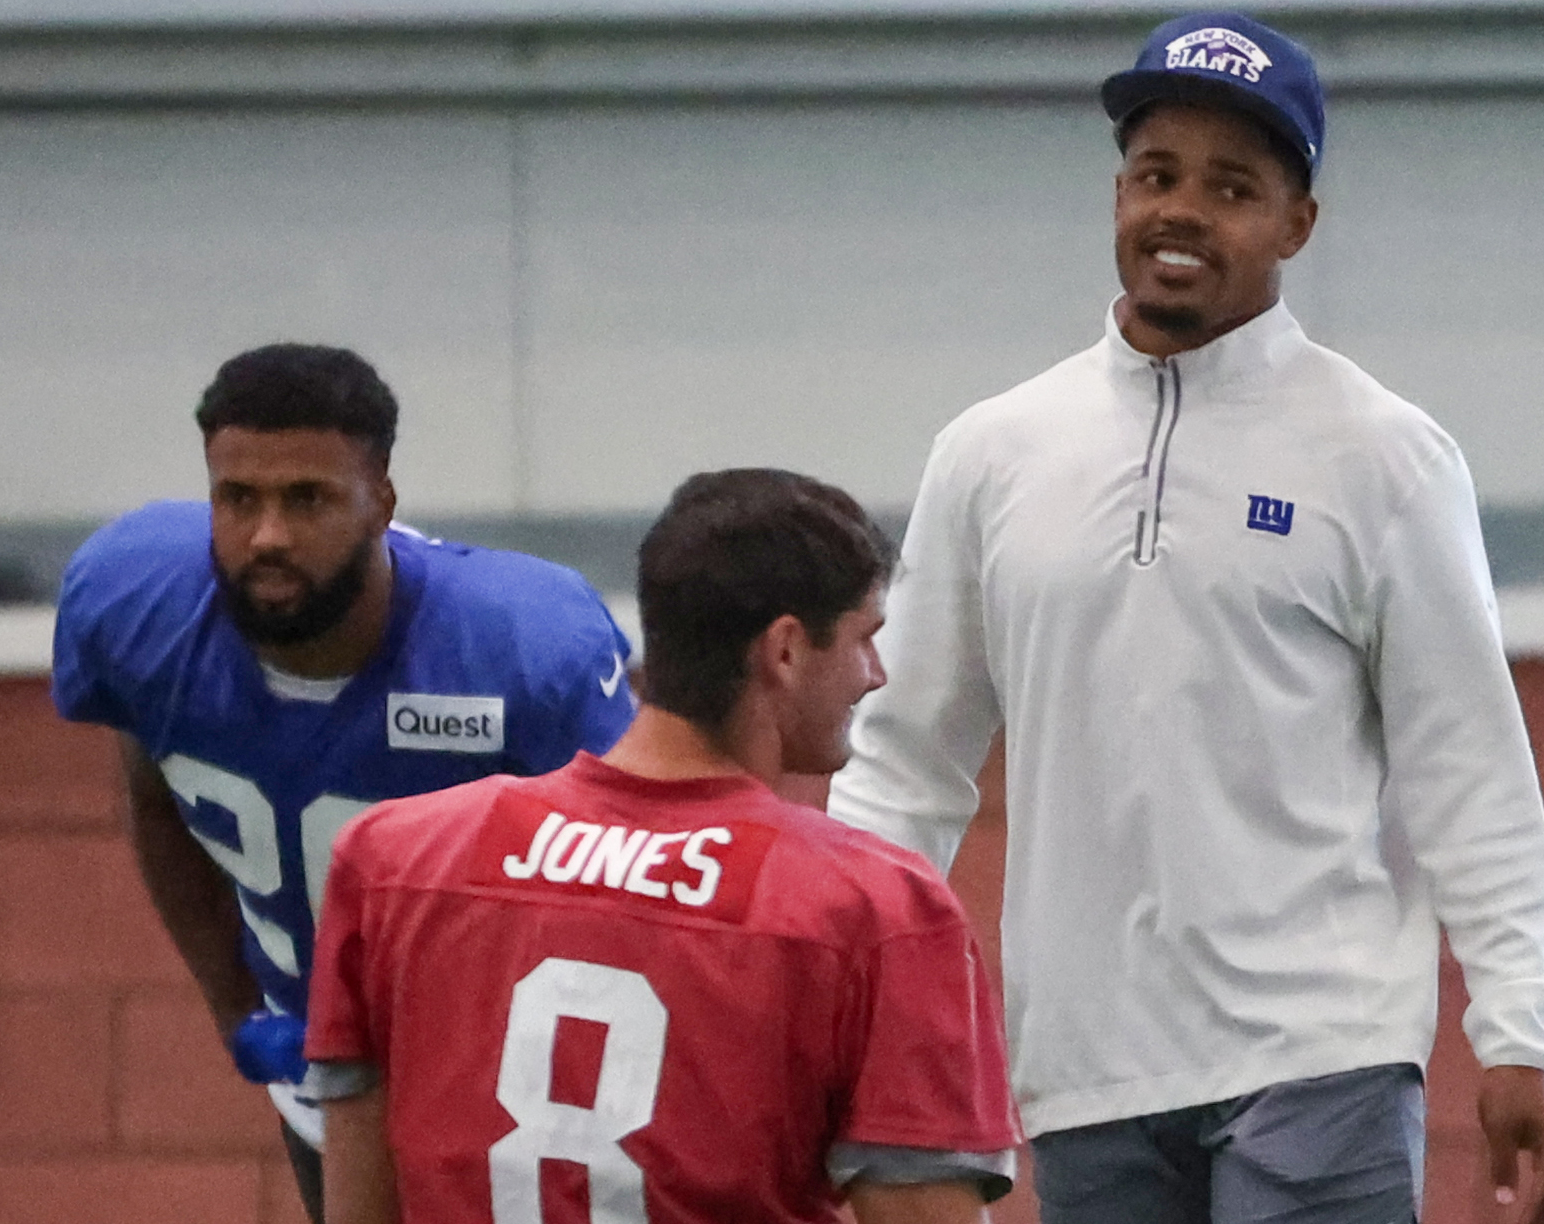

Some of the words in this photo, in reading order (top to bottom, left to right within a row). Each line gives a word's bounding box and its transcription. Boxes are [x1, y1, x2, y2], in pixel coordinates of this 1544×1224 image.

[1184, 30, 1215, 44] NEW
[1222, 31, 1257, 54] YORK
[1165, 48, 1261, 83] GIANTS
[394, 706, 492, 739] Quest
[502, 811, 732, 907] JONES
[159, 753, 381, 1016] 2
